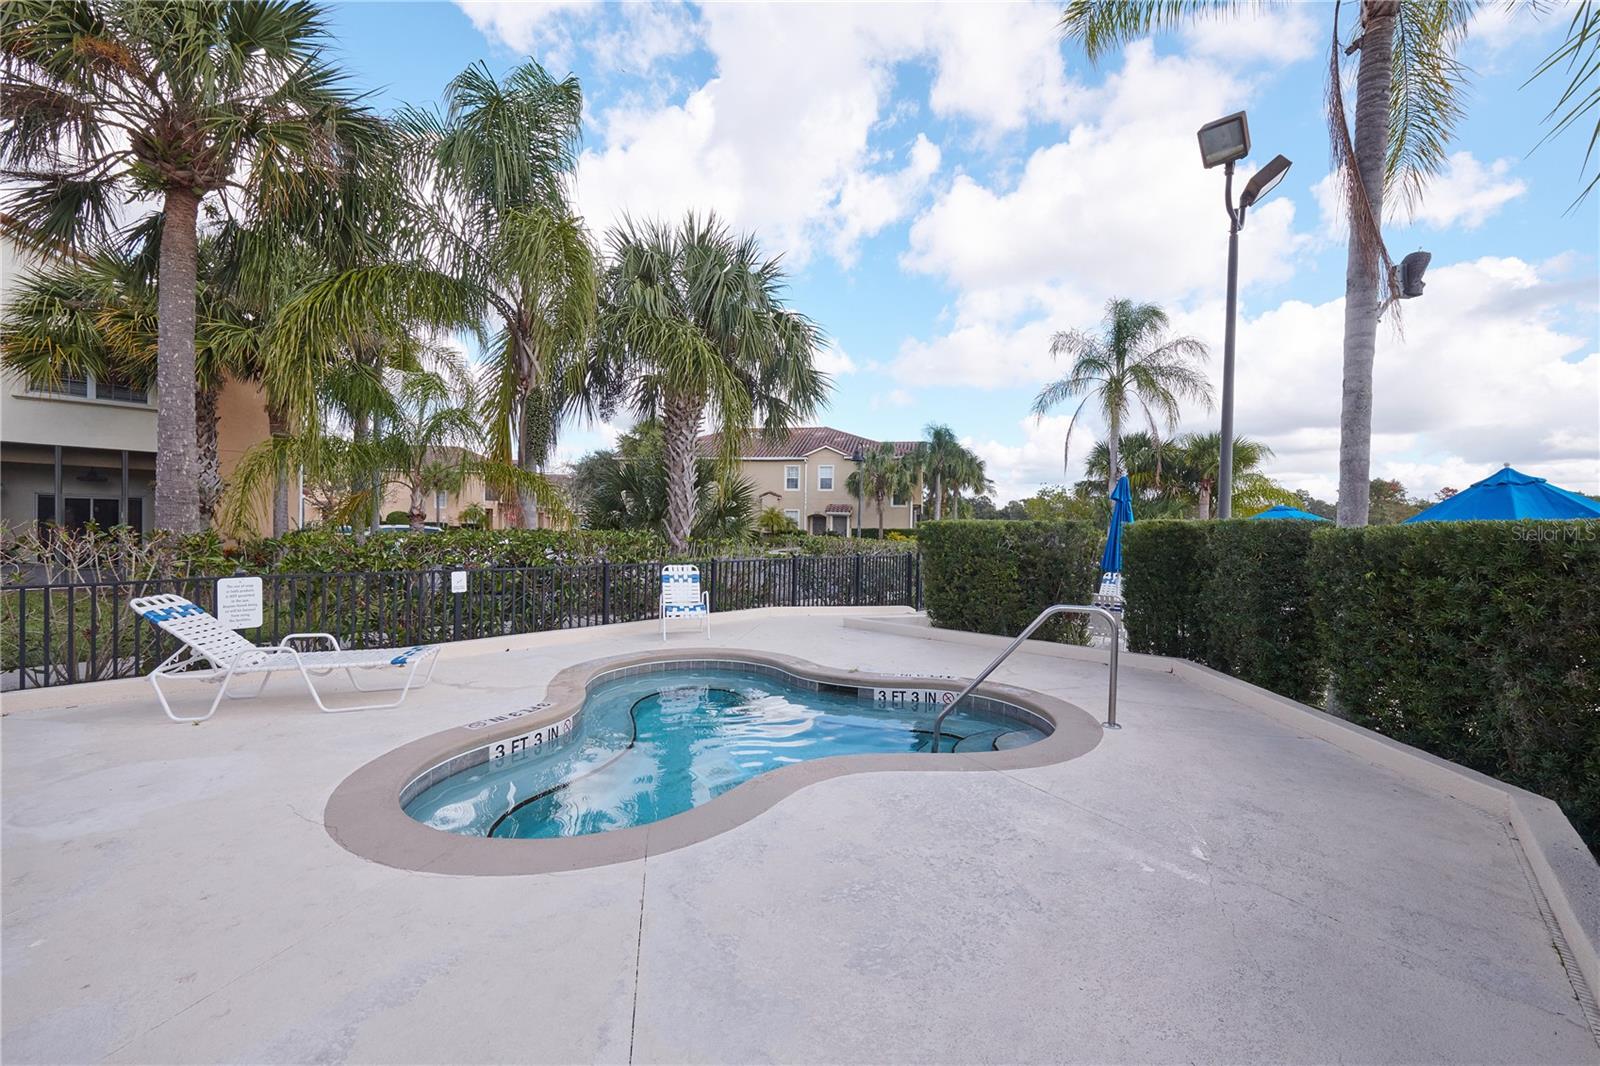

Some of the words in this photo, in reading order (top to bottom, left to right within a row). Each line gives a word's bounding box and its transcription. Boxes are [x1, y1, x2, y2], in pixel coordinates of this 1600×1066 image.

[878, 690, 886, 701] 3
[891, 691, 906, 703] FT
[911, 691, 919, 702] 3
[495, 744, 505, 759] 3
[511, 736, 528, 754] FT
[534, 732, 543, 746] 3
